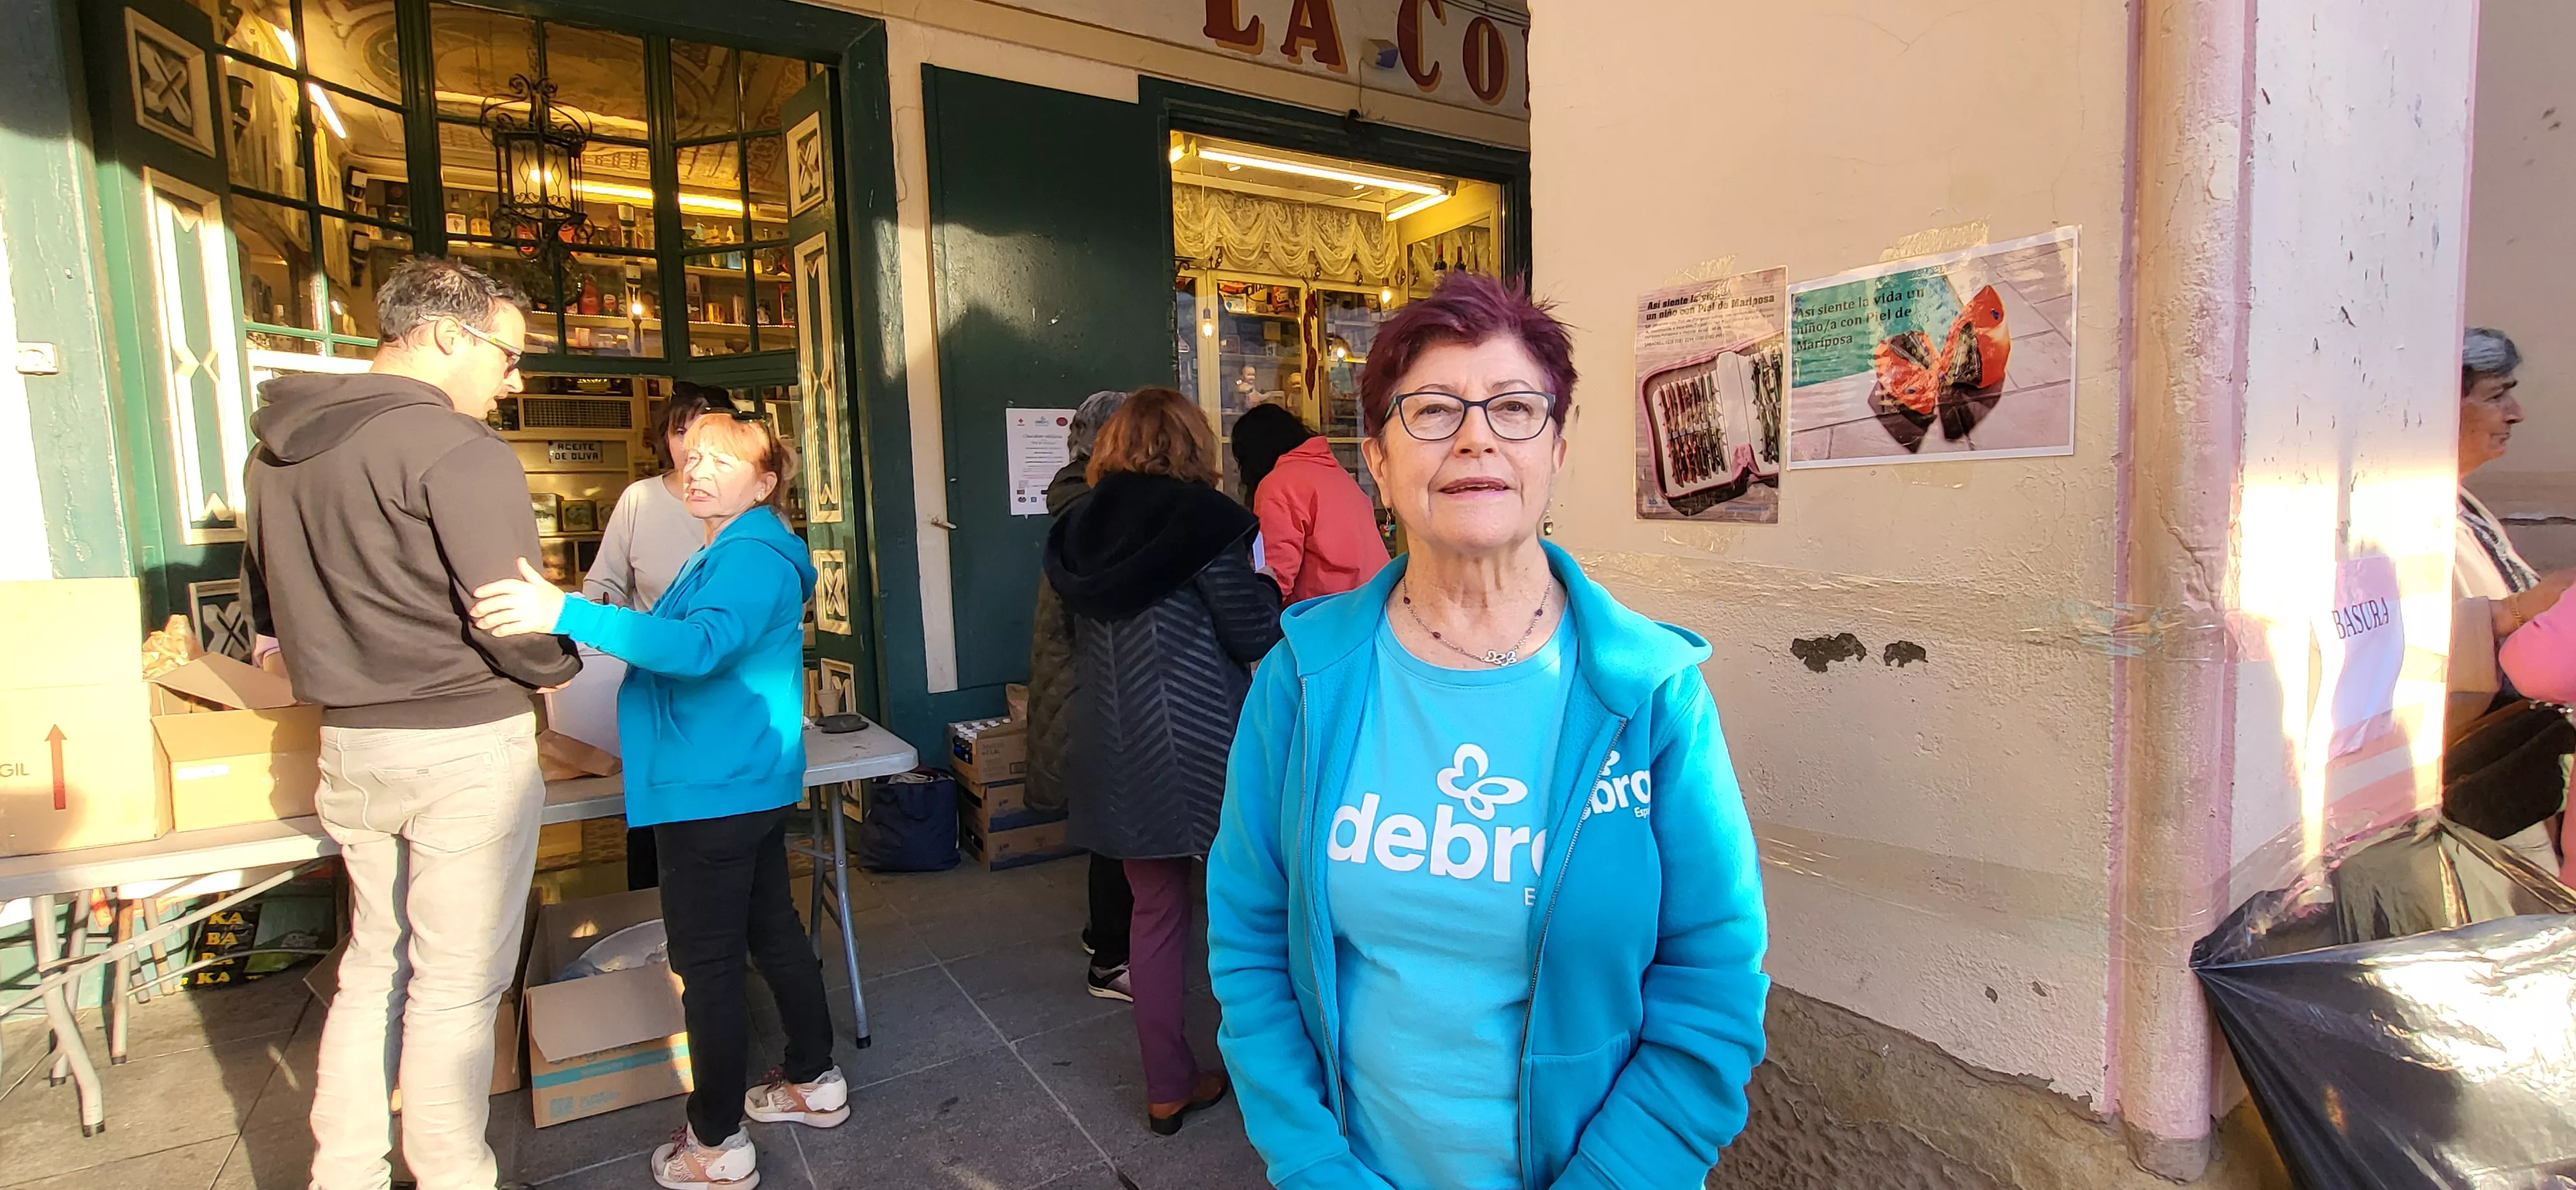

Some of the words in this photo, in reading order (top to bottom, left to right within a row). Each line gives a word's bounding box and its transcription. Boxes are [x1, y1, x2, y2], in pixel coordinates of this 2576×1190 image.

[1203, 0, 1347, 74] LA
[1397, 0, 1530, 109] CO
[1662, 297, 1689, 308] siente
[1680, 307, 1695, 316] con
[1698, 301, 1715, 314] Piel
[1718, 300, 1728, 310] de
[1731, 295, 1775, 308] Mariposa
[1797, 305, 1815, 319] Así
[1818, 301, 1855, 316] siente
[1859, 296, 1869, 309] la
[1874, 292, 1902, 305] vida
[1907, 288, 1924, 299] un
[1841, 316, 1863, 328] con
[1866, 309, 1891, 323] Piel
[1895, 307, 1913, 319] de
[1797, 334, 1853, 352] Mariposa
[2331, 596, 2389, 639] BASURA
[208, 912, 244, 925] KA
[205, 932, 238, 945] BA
[195, 972, 231, 985] KA
